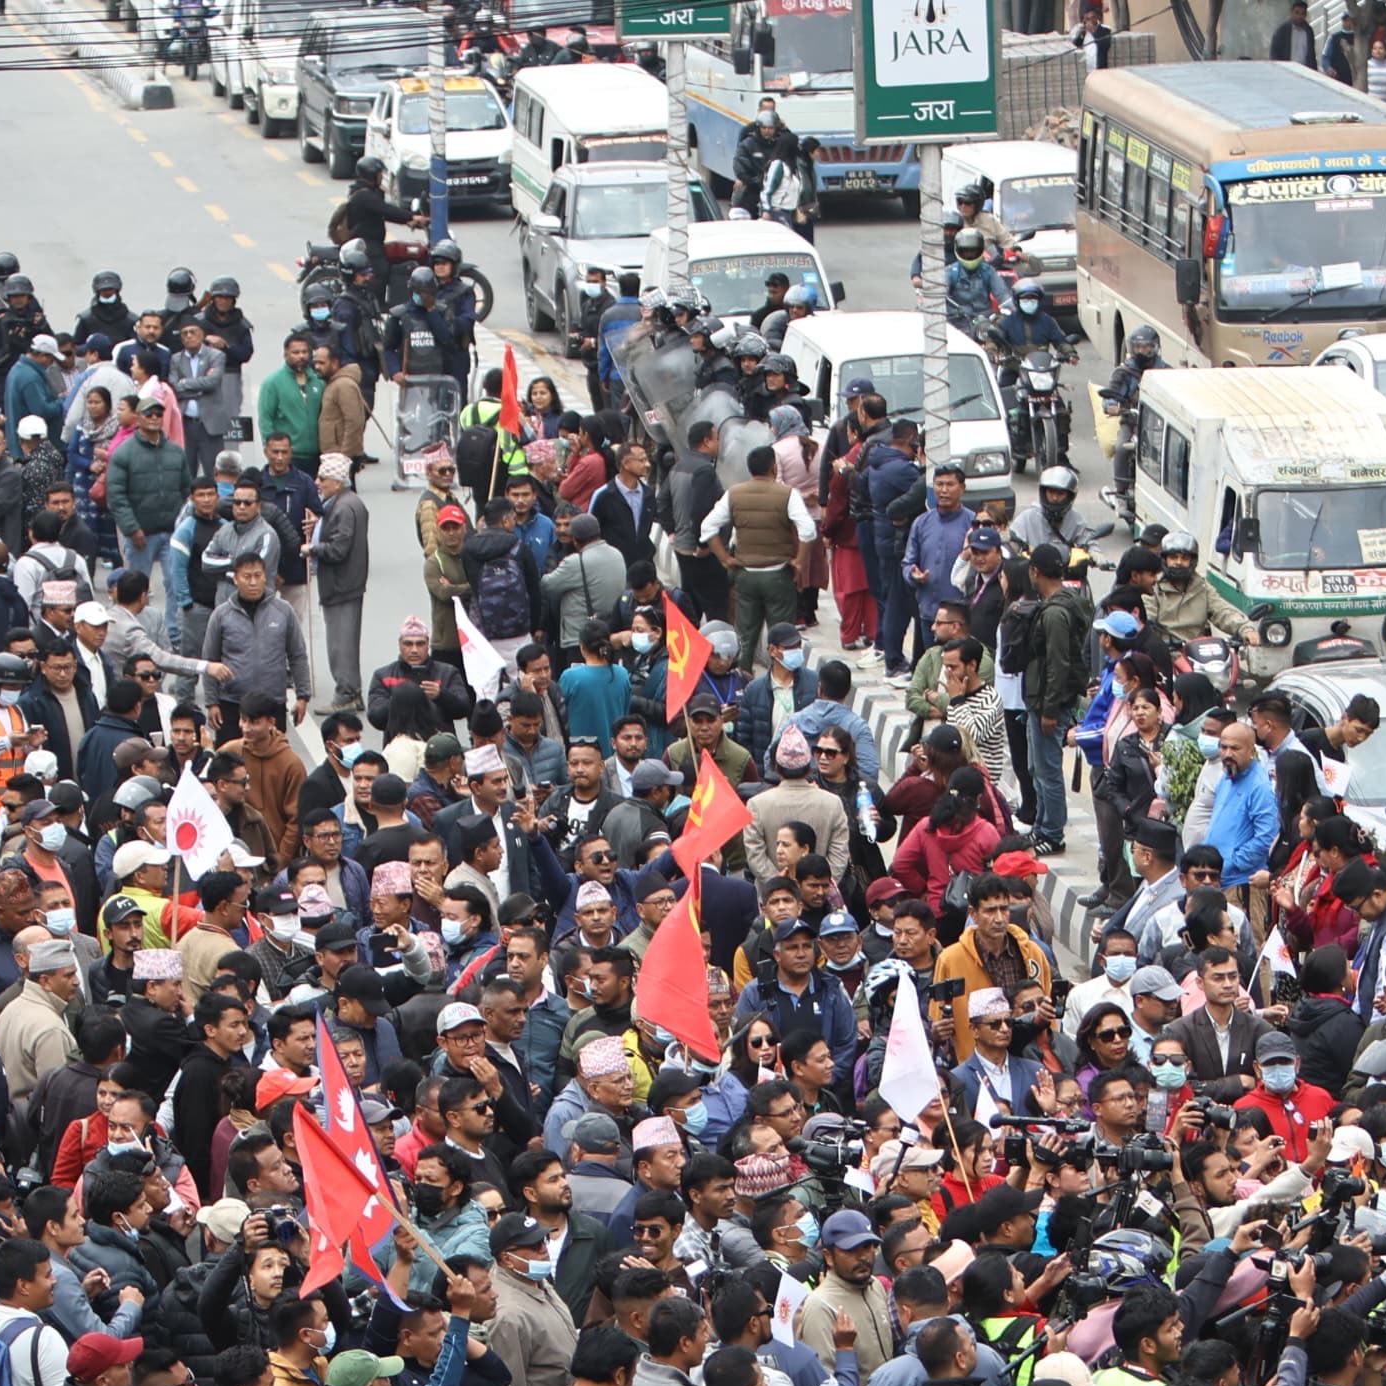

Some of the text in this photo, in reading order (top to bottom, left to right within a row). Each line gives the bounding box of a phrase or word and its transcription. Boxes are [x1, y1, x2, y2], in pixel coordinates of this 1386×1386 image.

[891, 28, 972, 62] JARA
[911, 100, 955, 121] जरा
[1246, 177, 1325, 198] नेपाल
